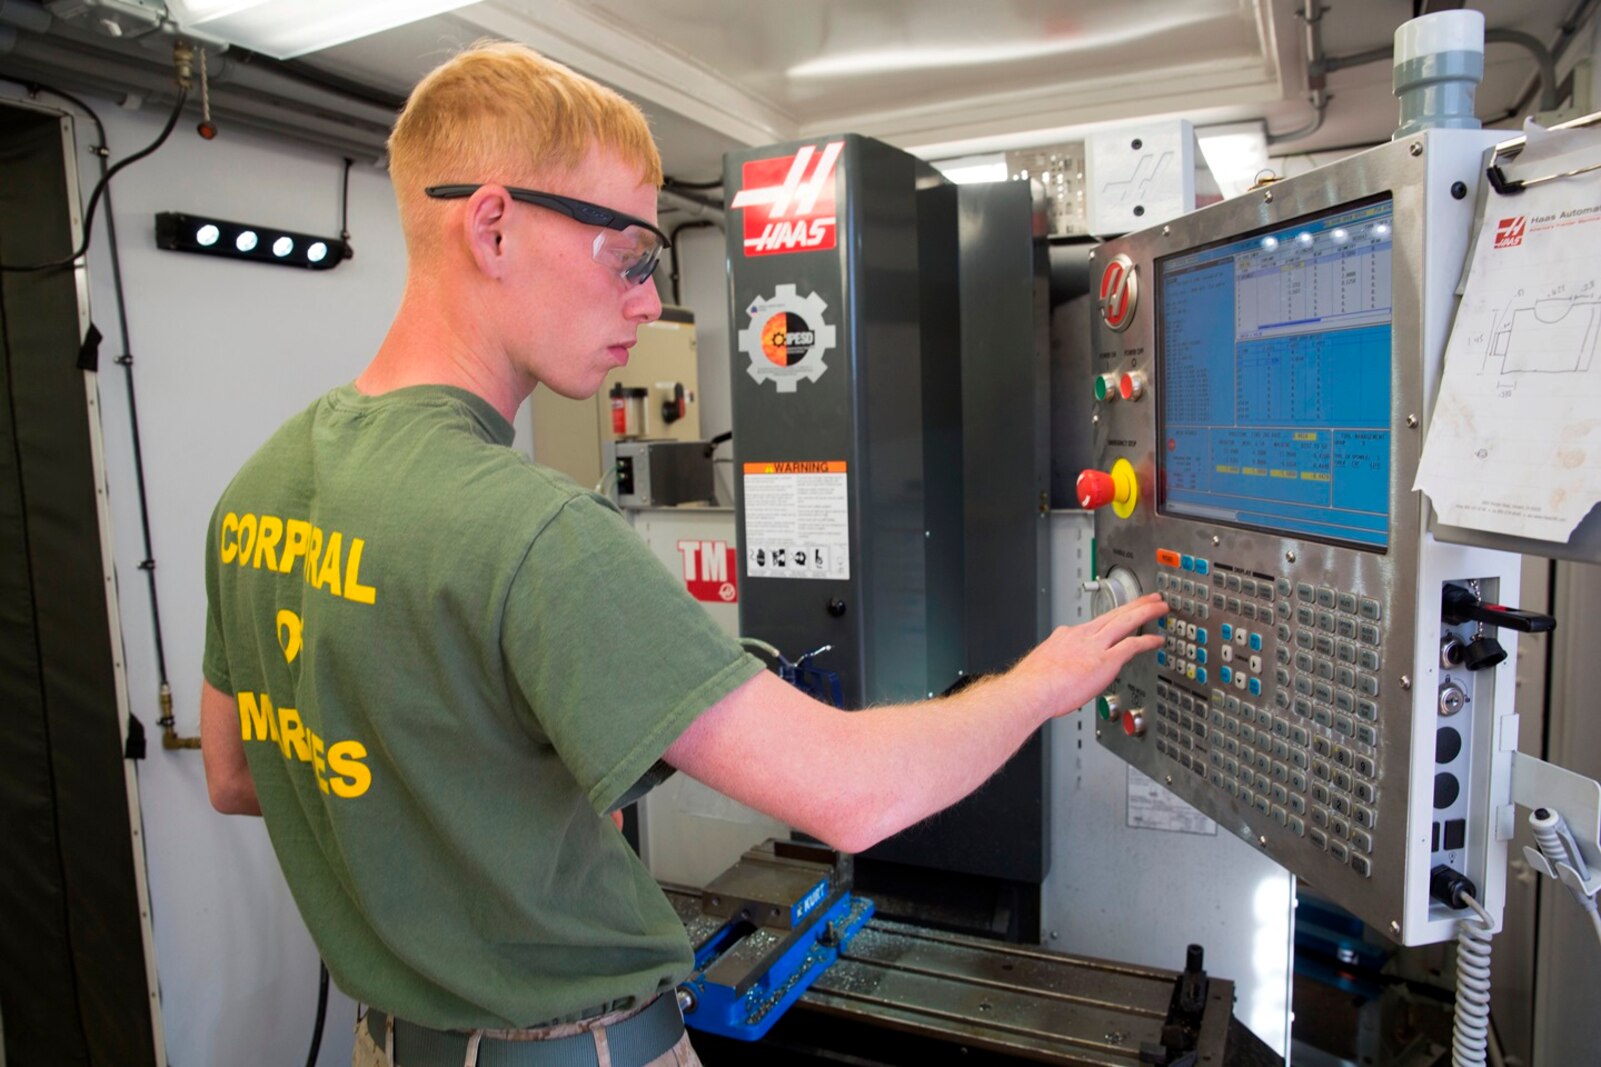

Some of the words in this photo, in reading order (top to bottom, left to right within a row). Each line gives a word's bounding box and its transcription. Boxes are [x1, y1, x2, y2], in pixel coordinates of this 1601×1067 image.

[744, 217, 836, 252] HAAS
[1531, 214, 1556, 224] Haas
[775, 462, 829, 473] WARNING
[220, 511, 376, 605] CORPRAL
[678, 540, 727, 582] TM
[276, 609, 304, 664] O
